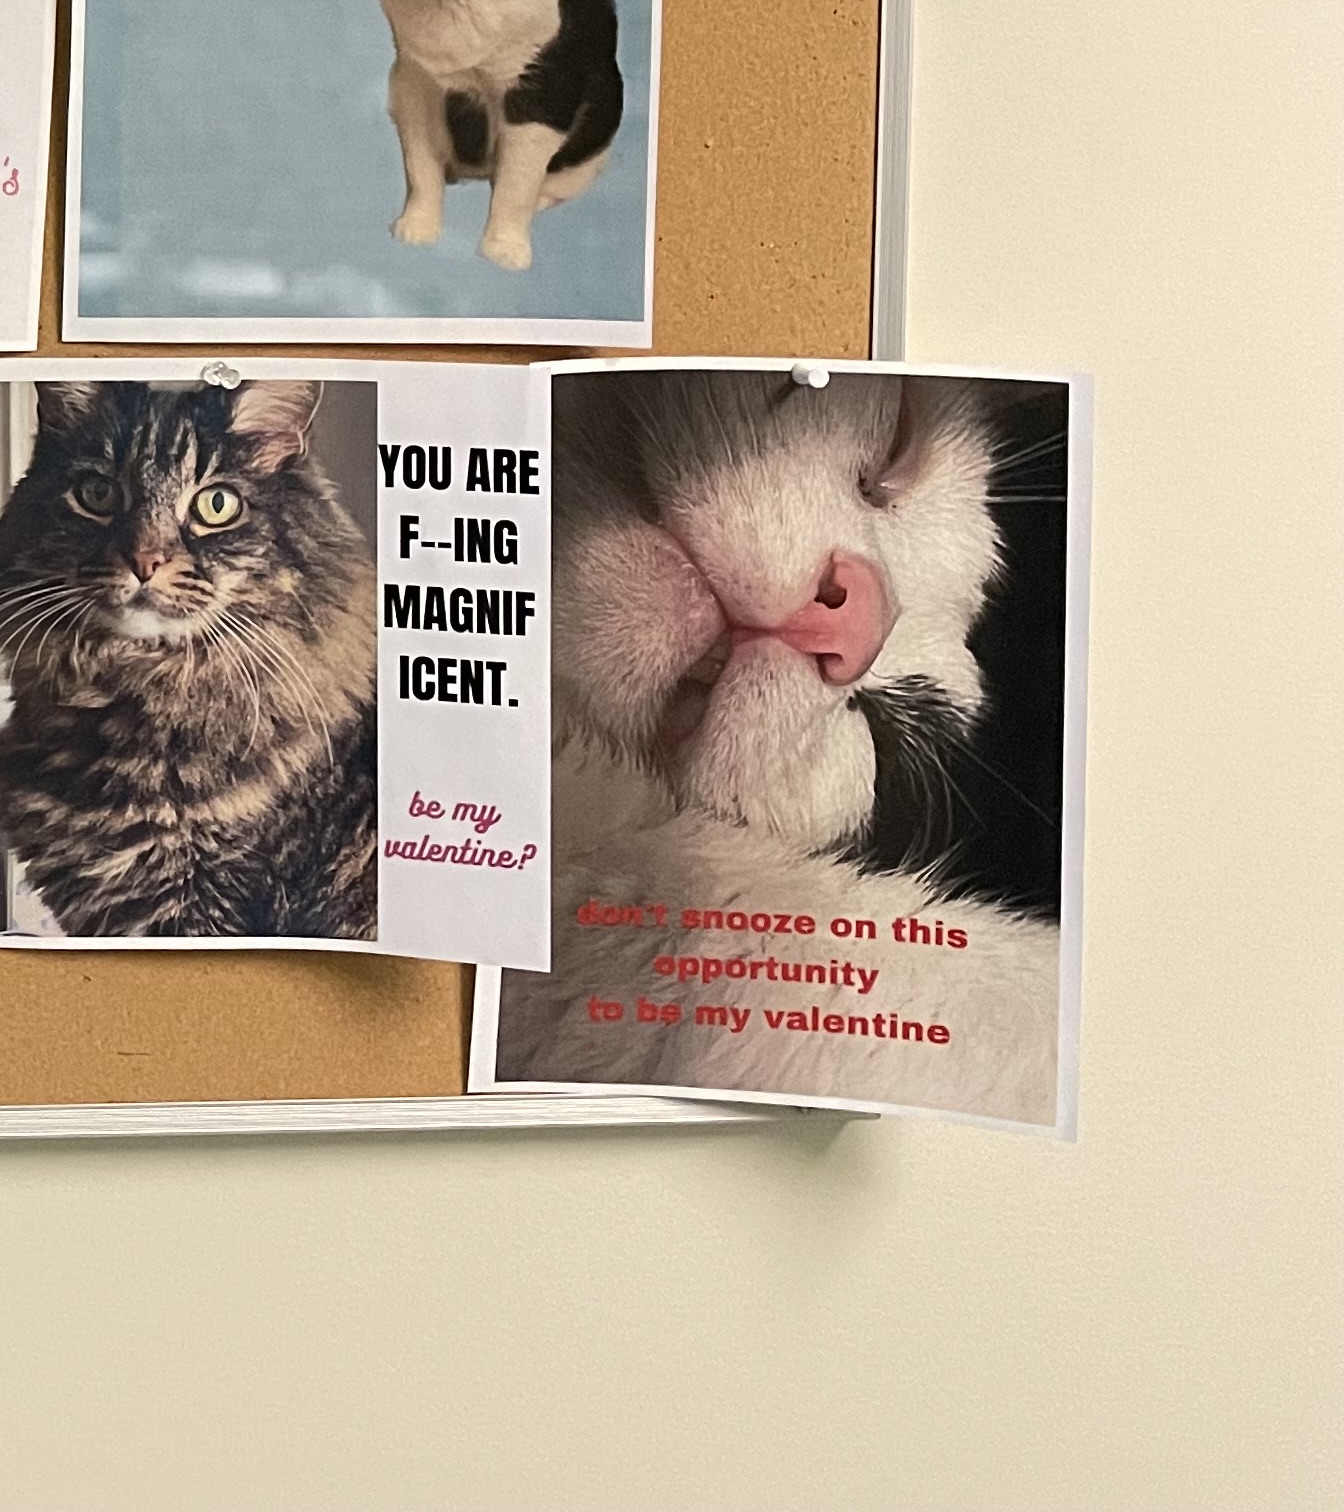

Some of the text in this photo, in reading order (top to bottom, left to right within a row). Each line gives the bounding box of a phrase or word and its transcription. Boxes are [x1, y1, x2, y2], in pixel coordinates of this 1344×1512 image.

[379, 444, 540, 495] YOU ARE
[400, 515, 518, 565] F--ING
[384, 584, 535, 636] MAGNIF
[400, 655, 519, 707] ICENT.
[409, 790, 502, 834] be my
[384, 834, 537, 870] valentine?
[680, 905, 969, 950] snooze on this
[654, 956, 879, 994] opportunity
[587, 995, 950, 1045] to be my valentine
